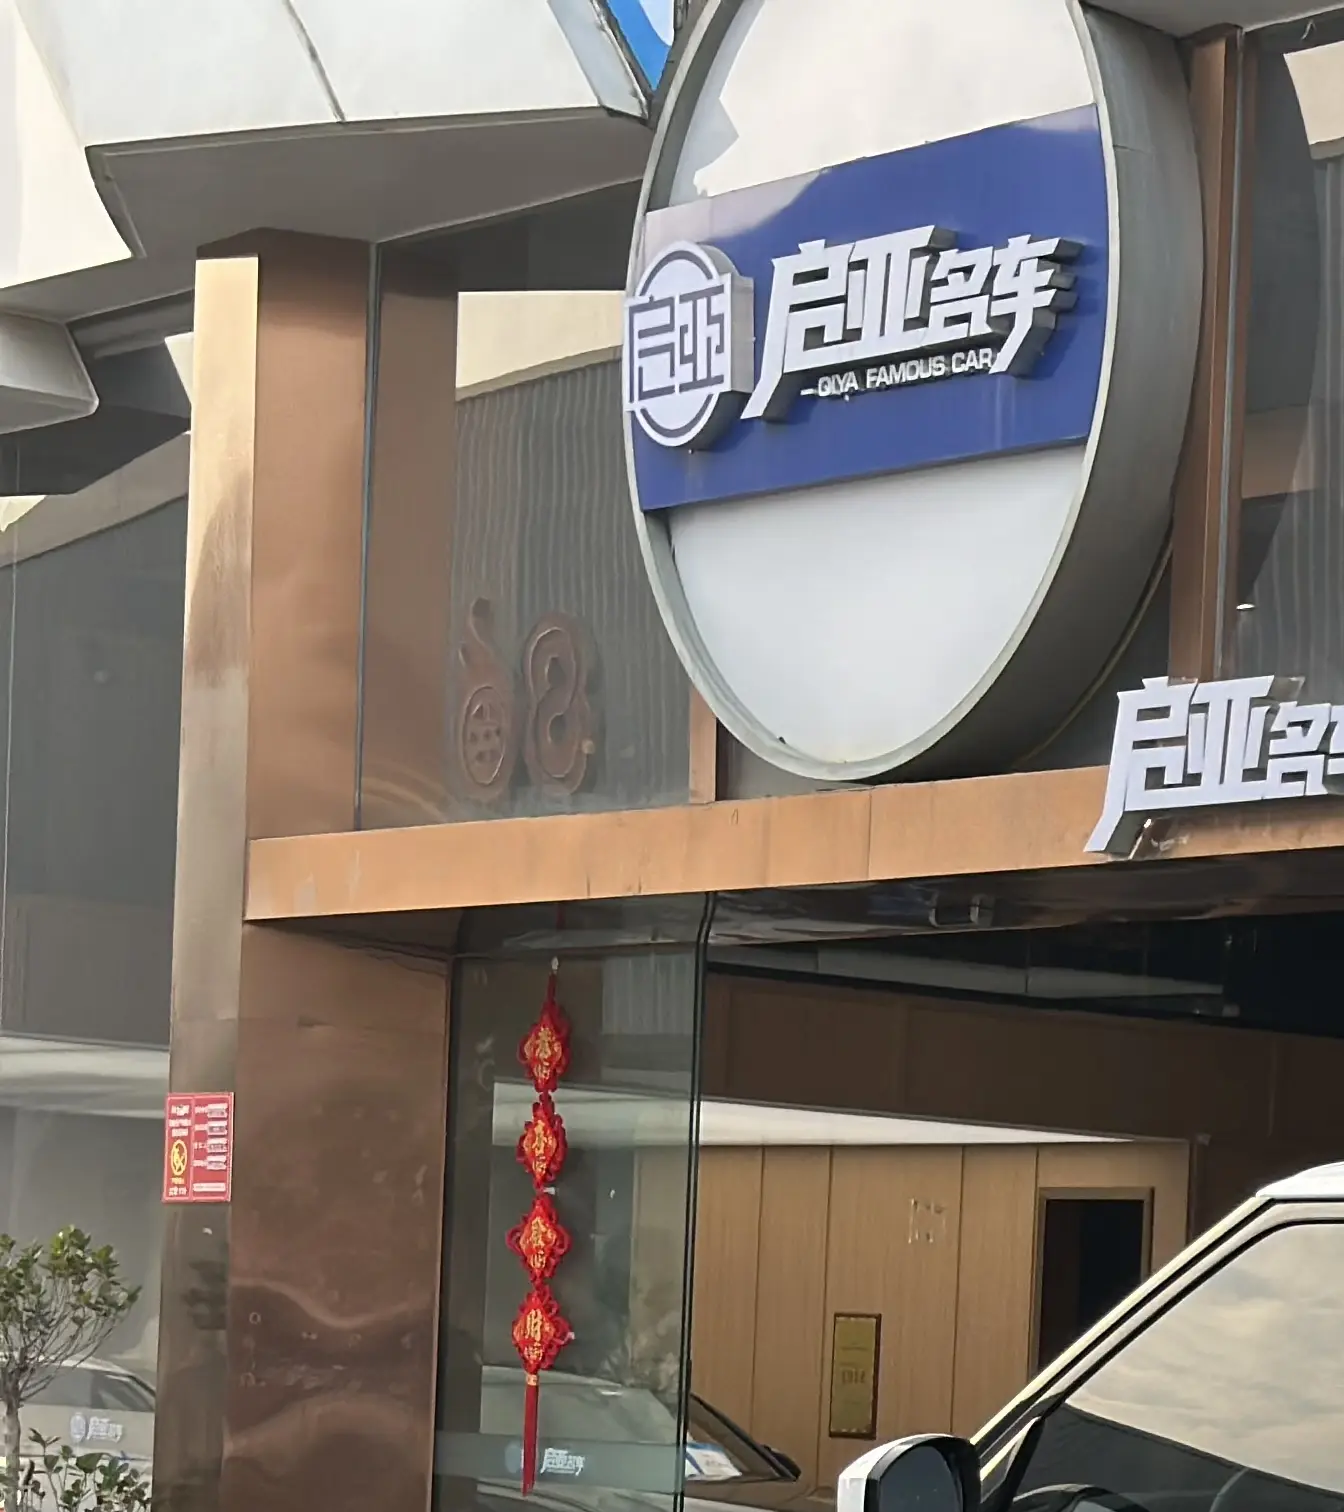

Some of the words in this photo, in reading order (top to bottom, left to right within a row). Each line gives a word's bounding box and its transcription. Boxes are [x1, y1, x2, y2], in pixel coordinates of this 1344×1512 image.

[741, 225, 1062, 419] 启亚名车
[817, 370, 859, 397] QIYA
[866, 356, 946, 390] FAMOUS
[951, 347, 993, 374] CAR
